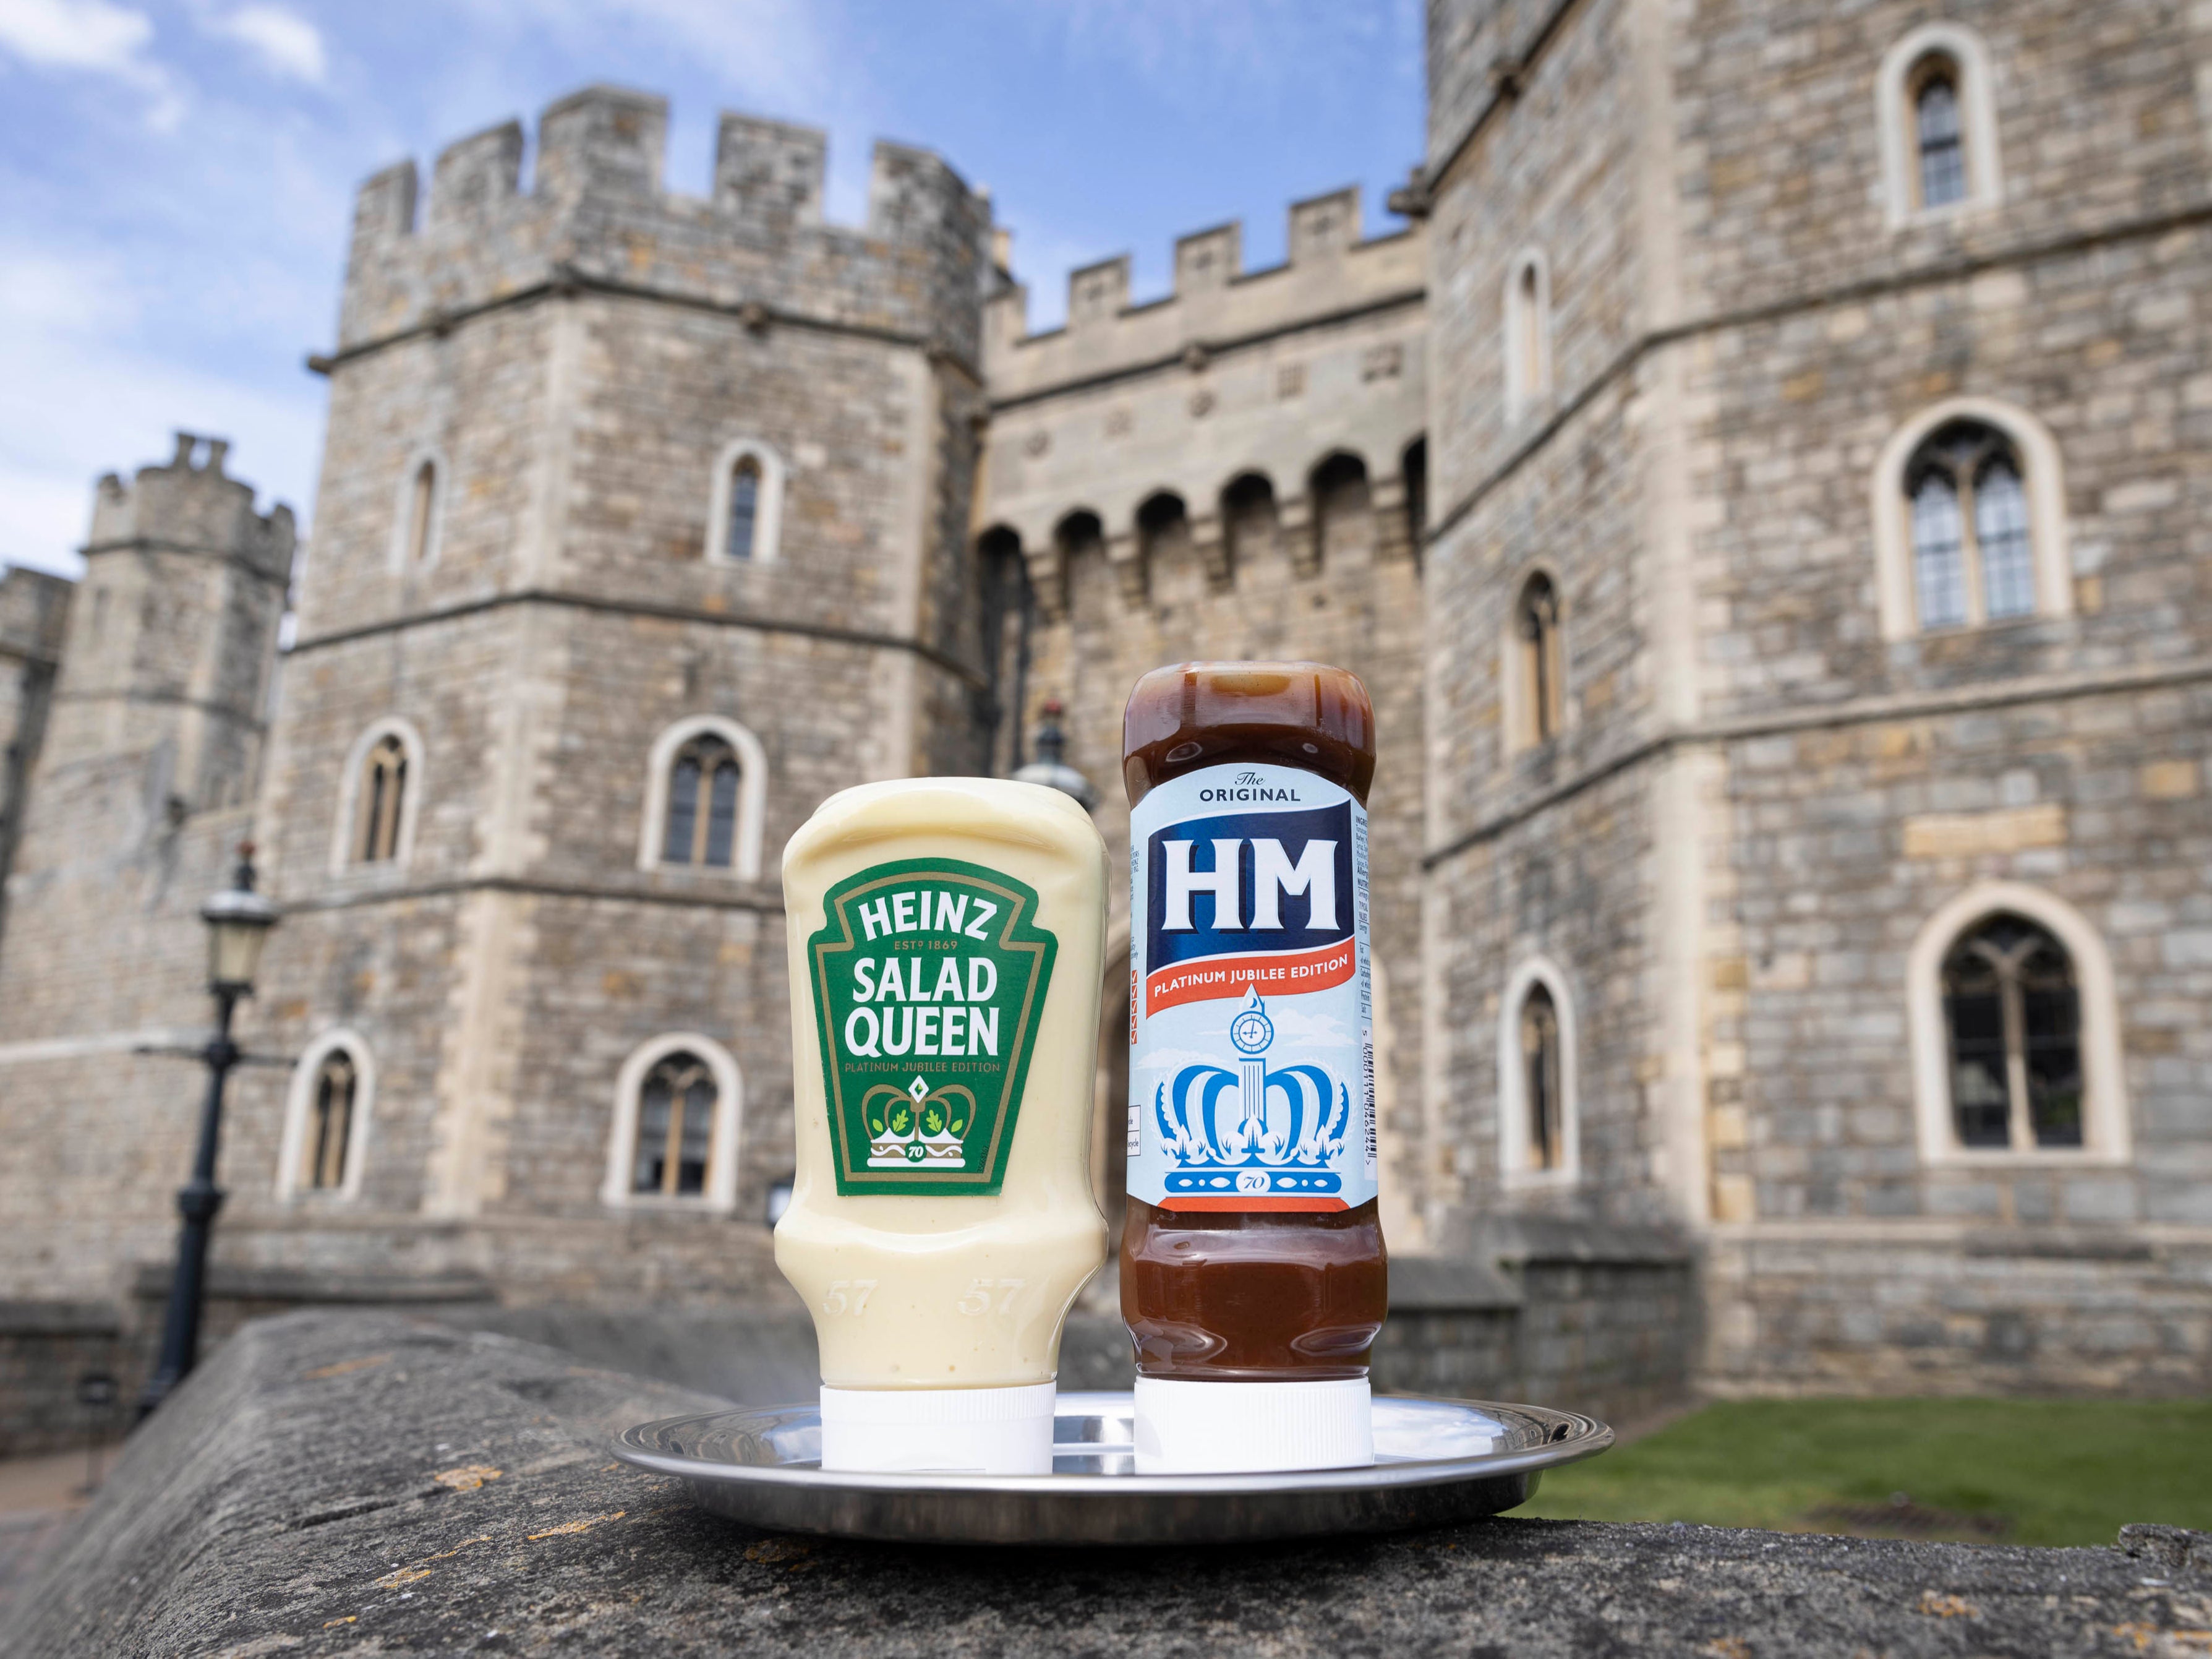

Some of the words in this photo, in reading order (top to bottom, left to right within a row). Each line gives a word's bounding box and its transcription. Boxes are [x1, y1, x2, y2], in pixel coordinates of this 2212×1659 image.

[1235, 772, 1265, 786] The
[1200, 789, 1300, 802] ORIGINAL
[1161, 838, 1341, 933] HM
[858, 891, 997, 941] HEINZ
[928, 940, 957, 950] 1869
[853, 957, 997, 1003] SALAD
[1155, 970, 1226, 997] PLATINUM
[1231, 968, 1286, 984] JUBILEE
[1291, 954, 1348, 978] EDITION
[845, 1006, 999, 1058] QUEEN
[845, 1063, 897, 1073] PLATINUM
[902, 1062, 947, 1072] JUBILEE
[952, 1062, 1000, 1072] EDITION
[908, 1146, 924, 1158] 70
[1243, 1176, 1265, 1189] 70
[822, 1279, 878, 1316] 57
[960, 1279, 1027, 1315] 57
